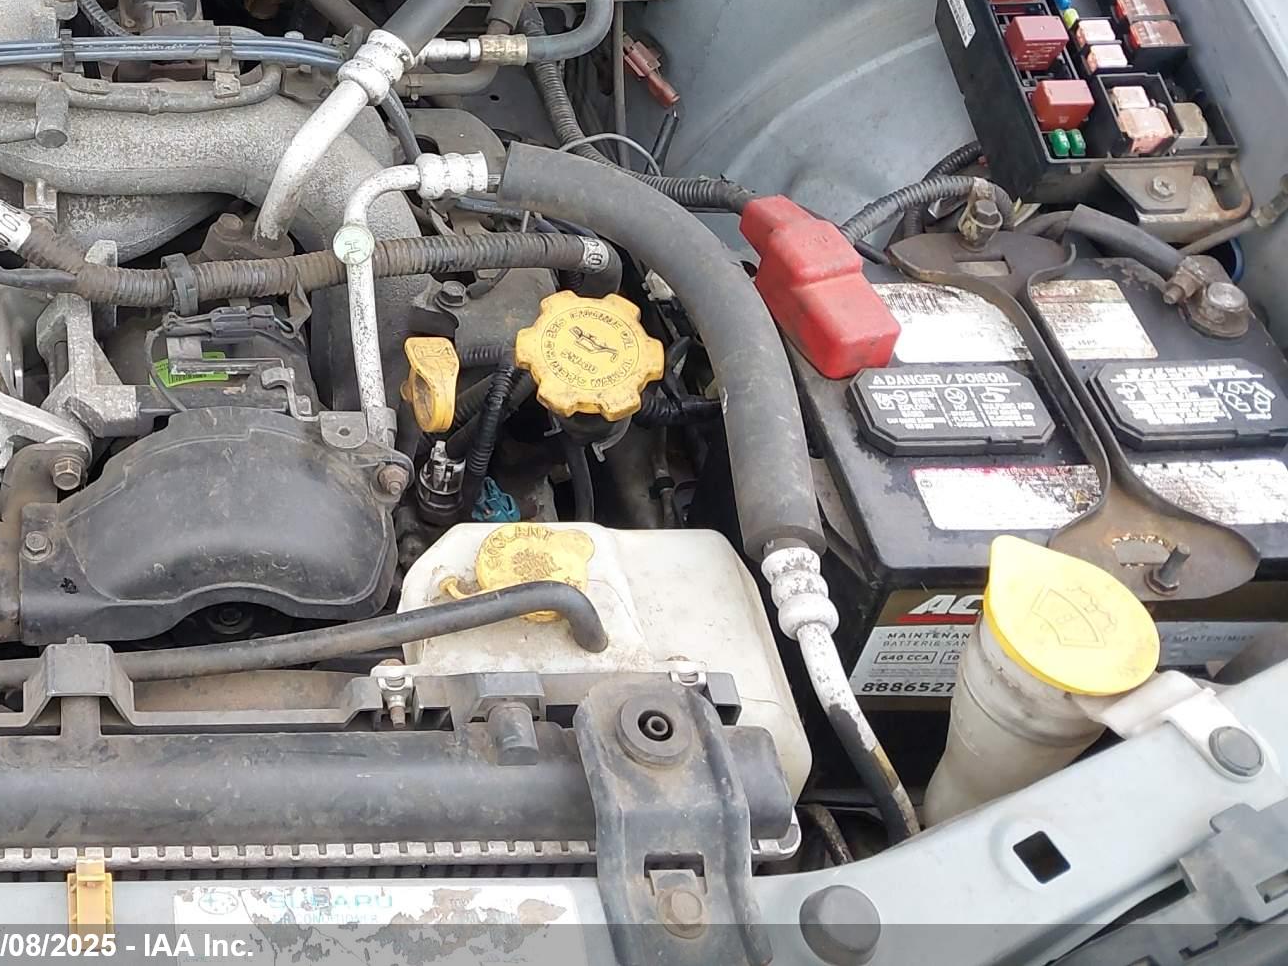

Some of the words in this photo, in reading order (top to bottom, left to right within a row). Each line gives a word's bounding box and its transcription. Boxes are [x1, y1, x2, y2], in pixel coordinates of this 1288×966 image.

[885, 373, 943, 385] DANGER
[957, 372, 1009, 384] POISON
[909, 594, 985, 615] AC
[887, 632, 971, 640] MAINTENAN
[861, 682, 957, 693] 8886527
